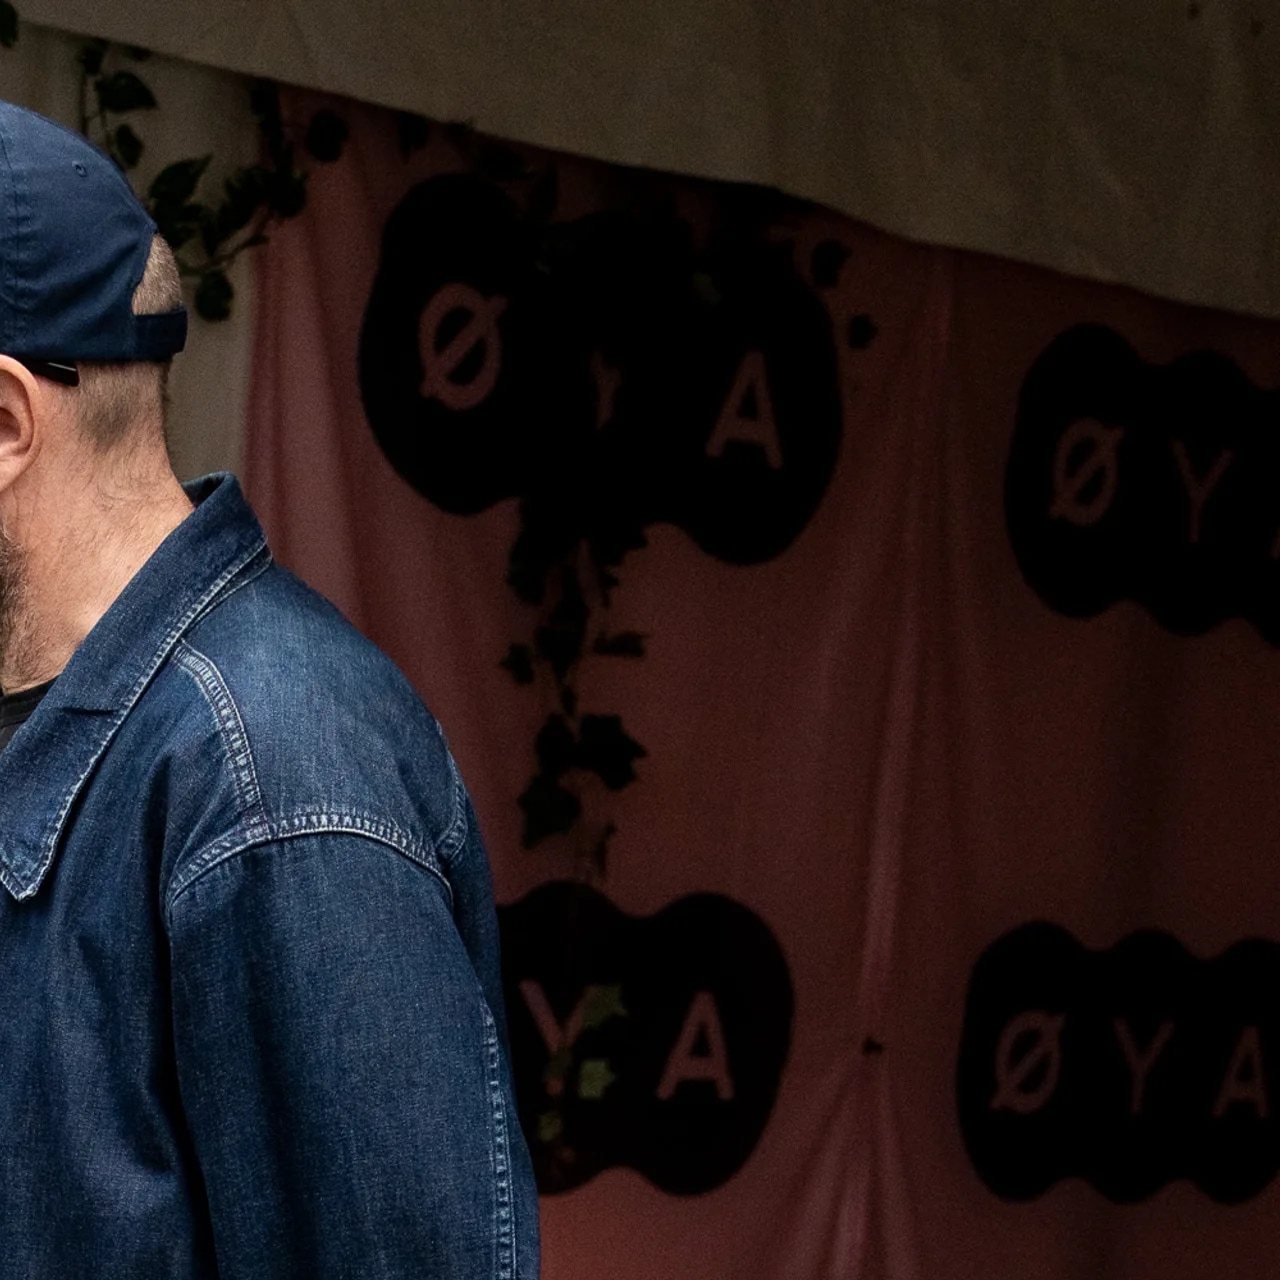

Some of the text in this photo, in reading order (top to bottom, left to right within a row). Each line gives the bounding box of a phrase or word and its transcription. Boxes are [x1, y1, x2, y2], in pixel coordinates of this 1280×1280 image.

[1046, 415, 1280, 562] ØY
[518, 977, 737, 1103] YA
[987, 1006, 1272, 1120] ØYA
